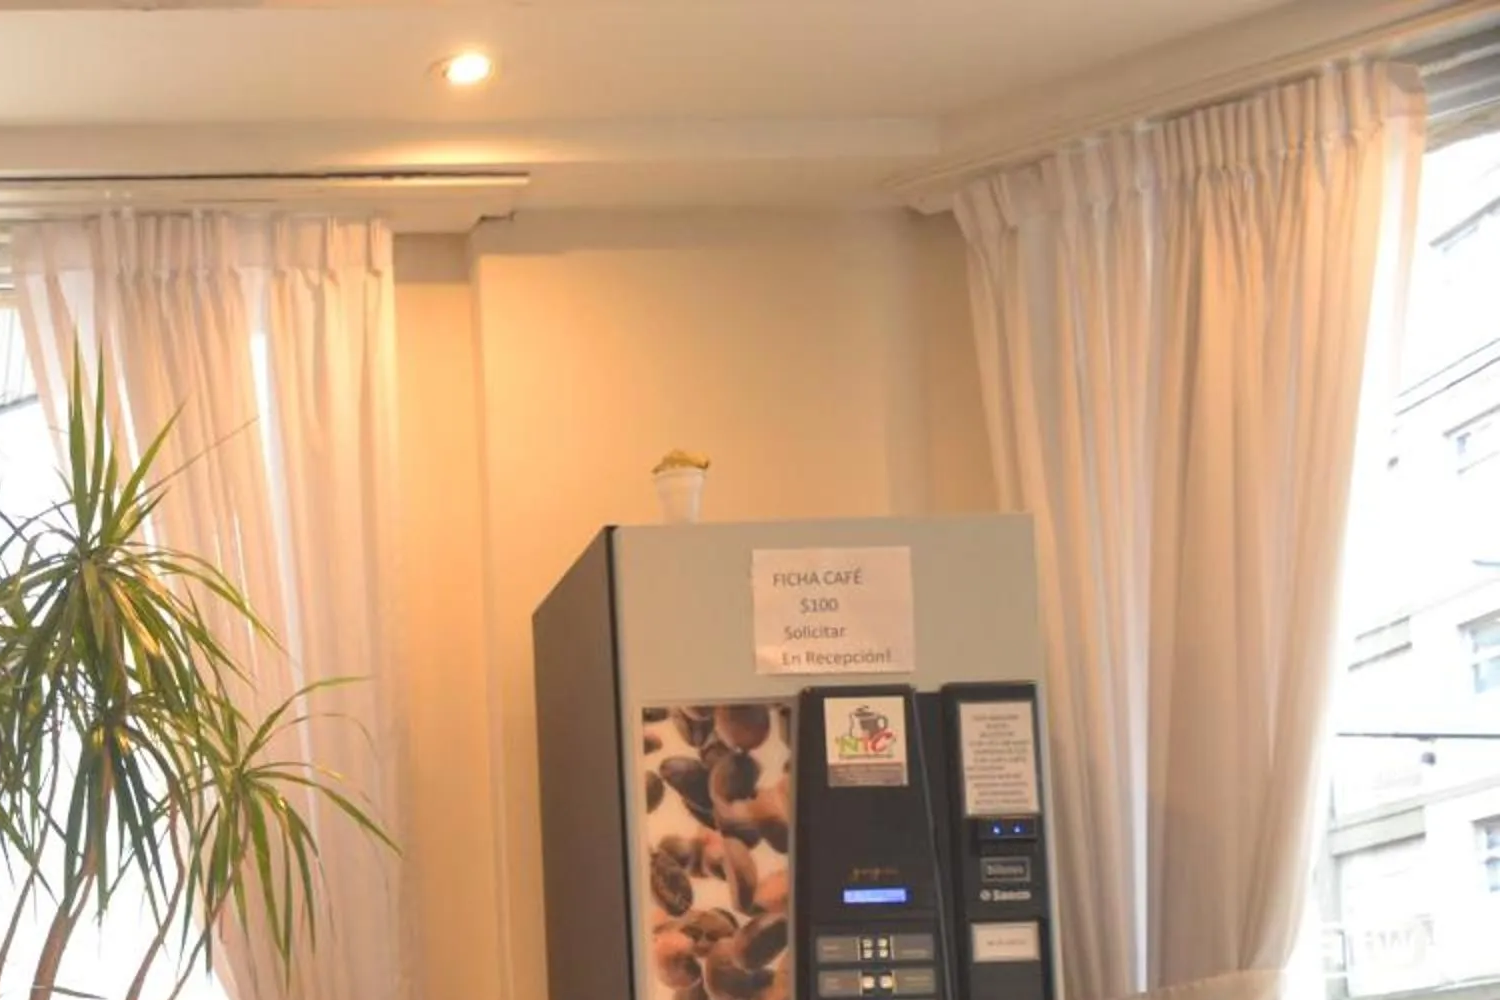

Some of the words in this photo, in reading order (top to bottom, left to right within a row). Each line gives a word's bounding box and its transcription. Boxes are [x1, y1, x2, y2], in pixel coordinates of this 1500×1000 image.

[772, 571, 820, 587] FICHA
[823, 567, 863, 585] CAFÉ
[800, 597, 839, 614] $100
[783, 625, 846, 640] Solicitar
[781, 652, 801, 665] En
